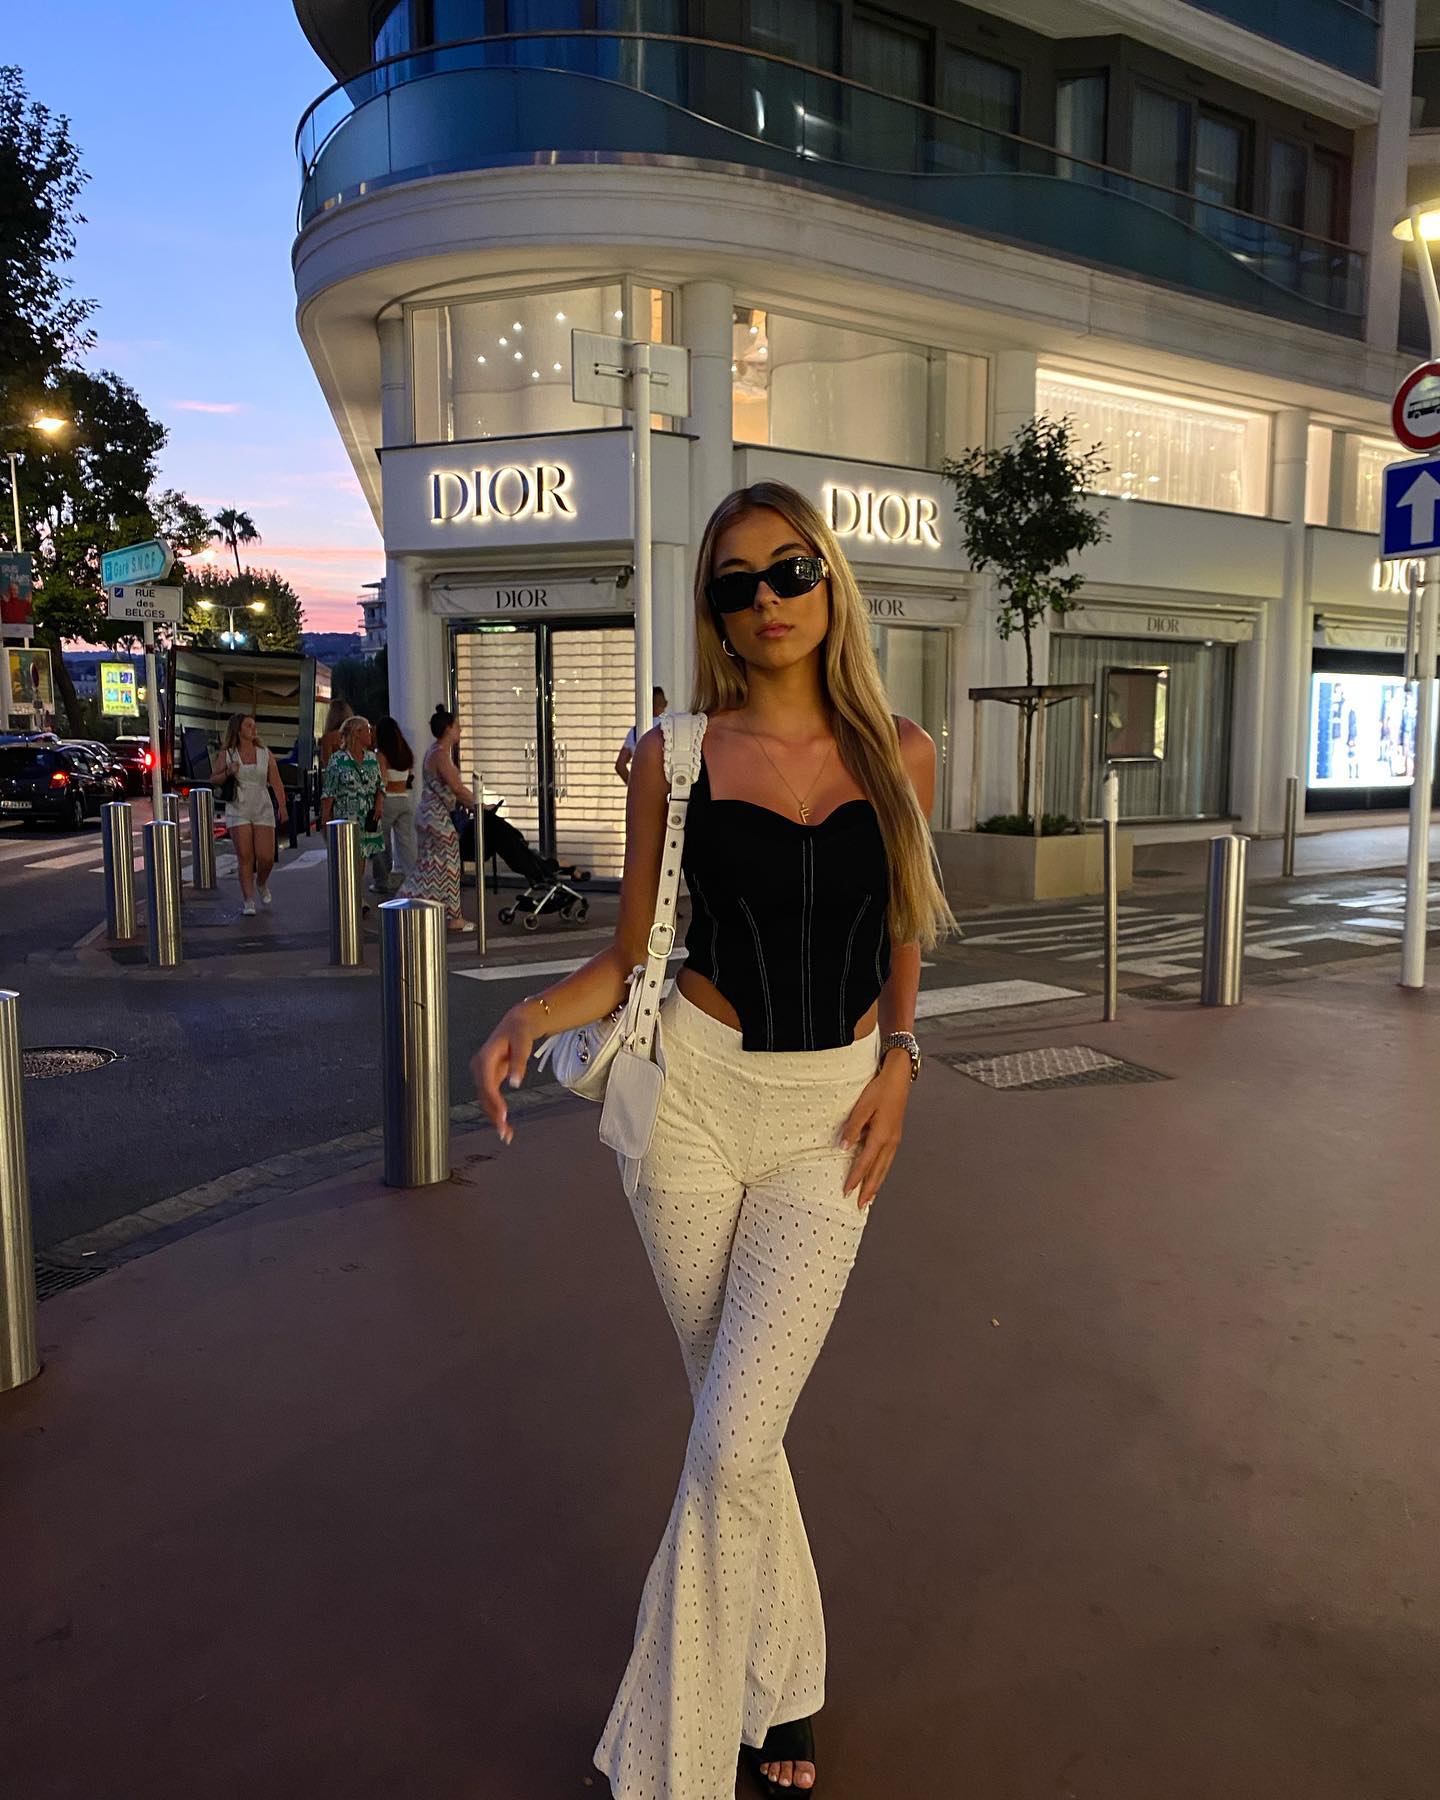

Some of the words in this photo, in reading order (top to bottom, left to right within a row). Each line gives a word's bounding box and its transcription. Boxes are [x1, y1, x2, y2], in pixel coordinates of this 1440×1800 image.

[431, 465, 576, 521] DIOR
[827, 486, 941, 547] DIOR
[135, 588, 156, 598] RUE
[496, 589, 548, 609] DIOR
[125, 608, 165, 618] BELGES
[136, 600, 154, 608] des
[1147, 615, 1180, 633] DIOR
